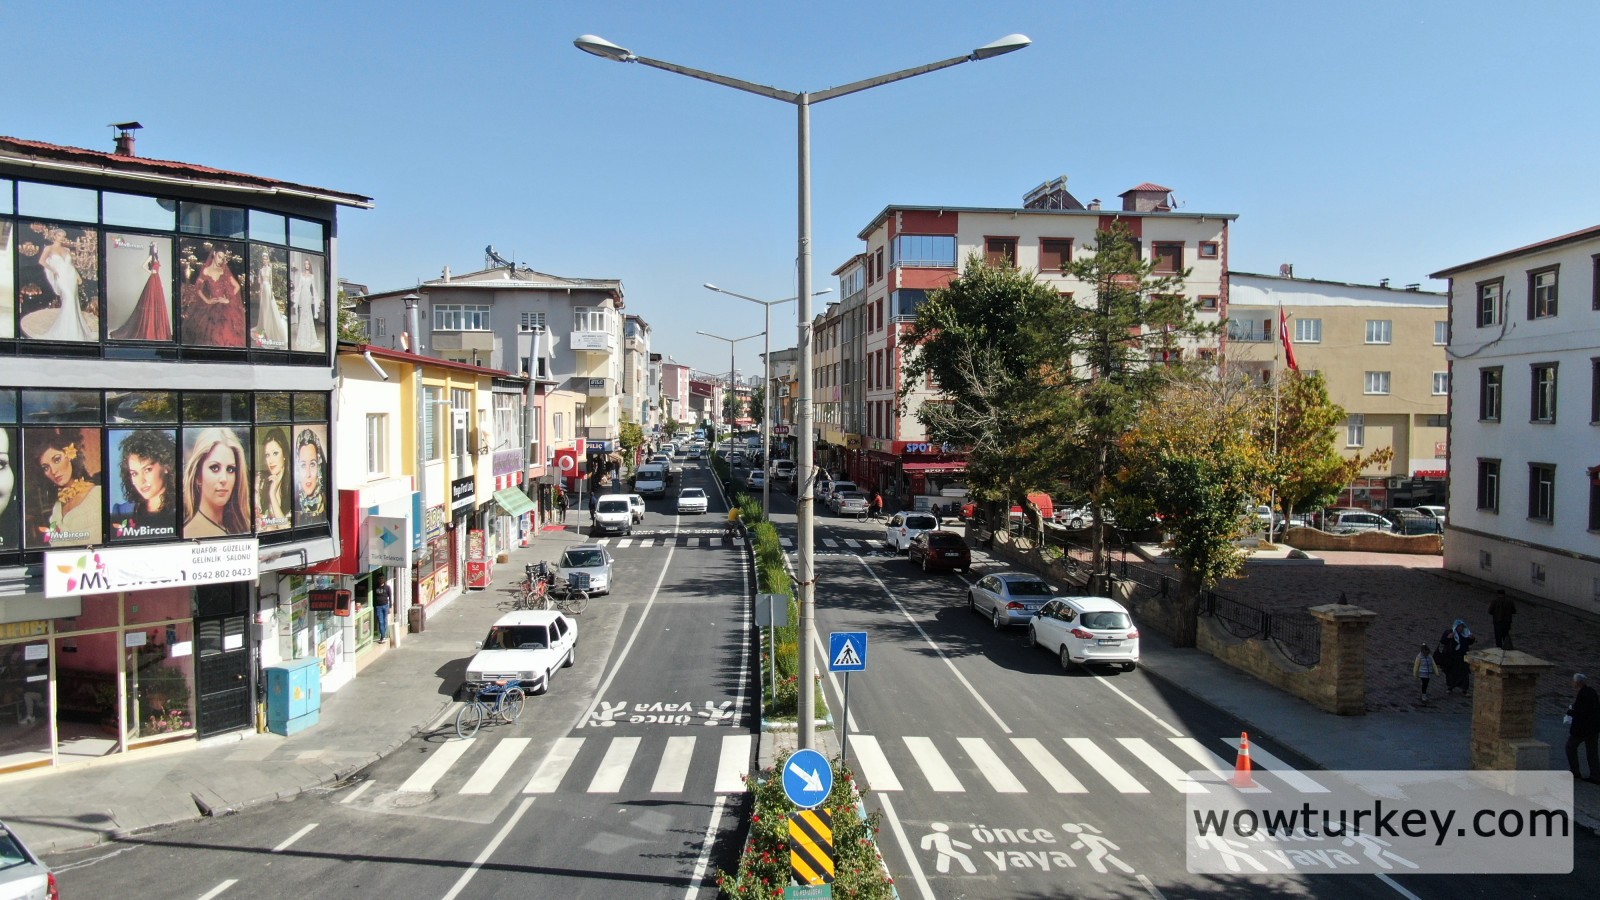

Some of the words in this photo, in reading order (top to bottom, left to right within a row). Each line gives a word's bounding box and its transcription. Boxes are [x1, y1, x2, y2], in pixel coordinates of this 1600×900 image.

[906, 442, 933, 453] SPOT
[50, 531, 90, 539] MyBircan
[123, 526, 174, 537] MyBircan
[191, 545, 218, 555] KUAFÖR
[222, 543, 252, 553] GÜZELLİK
[192, 554, 222, 564] GELİNLİK
[226, 552, 251, 562] SALONU
[383, 554, 404, 562] Telekom
[192, 570, 213, 581] 0542
[214, 569, 232, 579] 802
[231, 567, 252, 577] 0423
[634, 701, 693, 712] yaya
[629, 714, 691, 726] önce
[969, 824, 1057, 844] önce
[983, 851, 1077, 871] yaya
[1260, 849, 1360, 870] yaya
